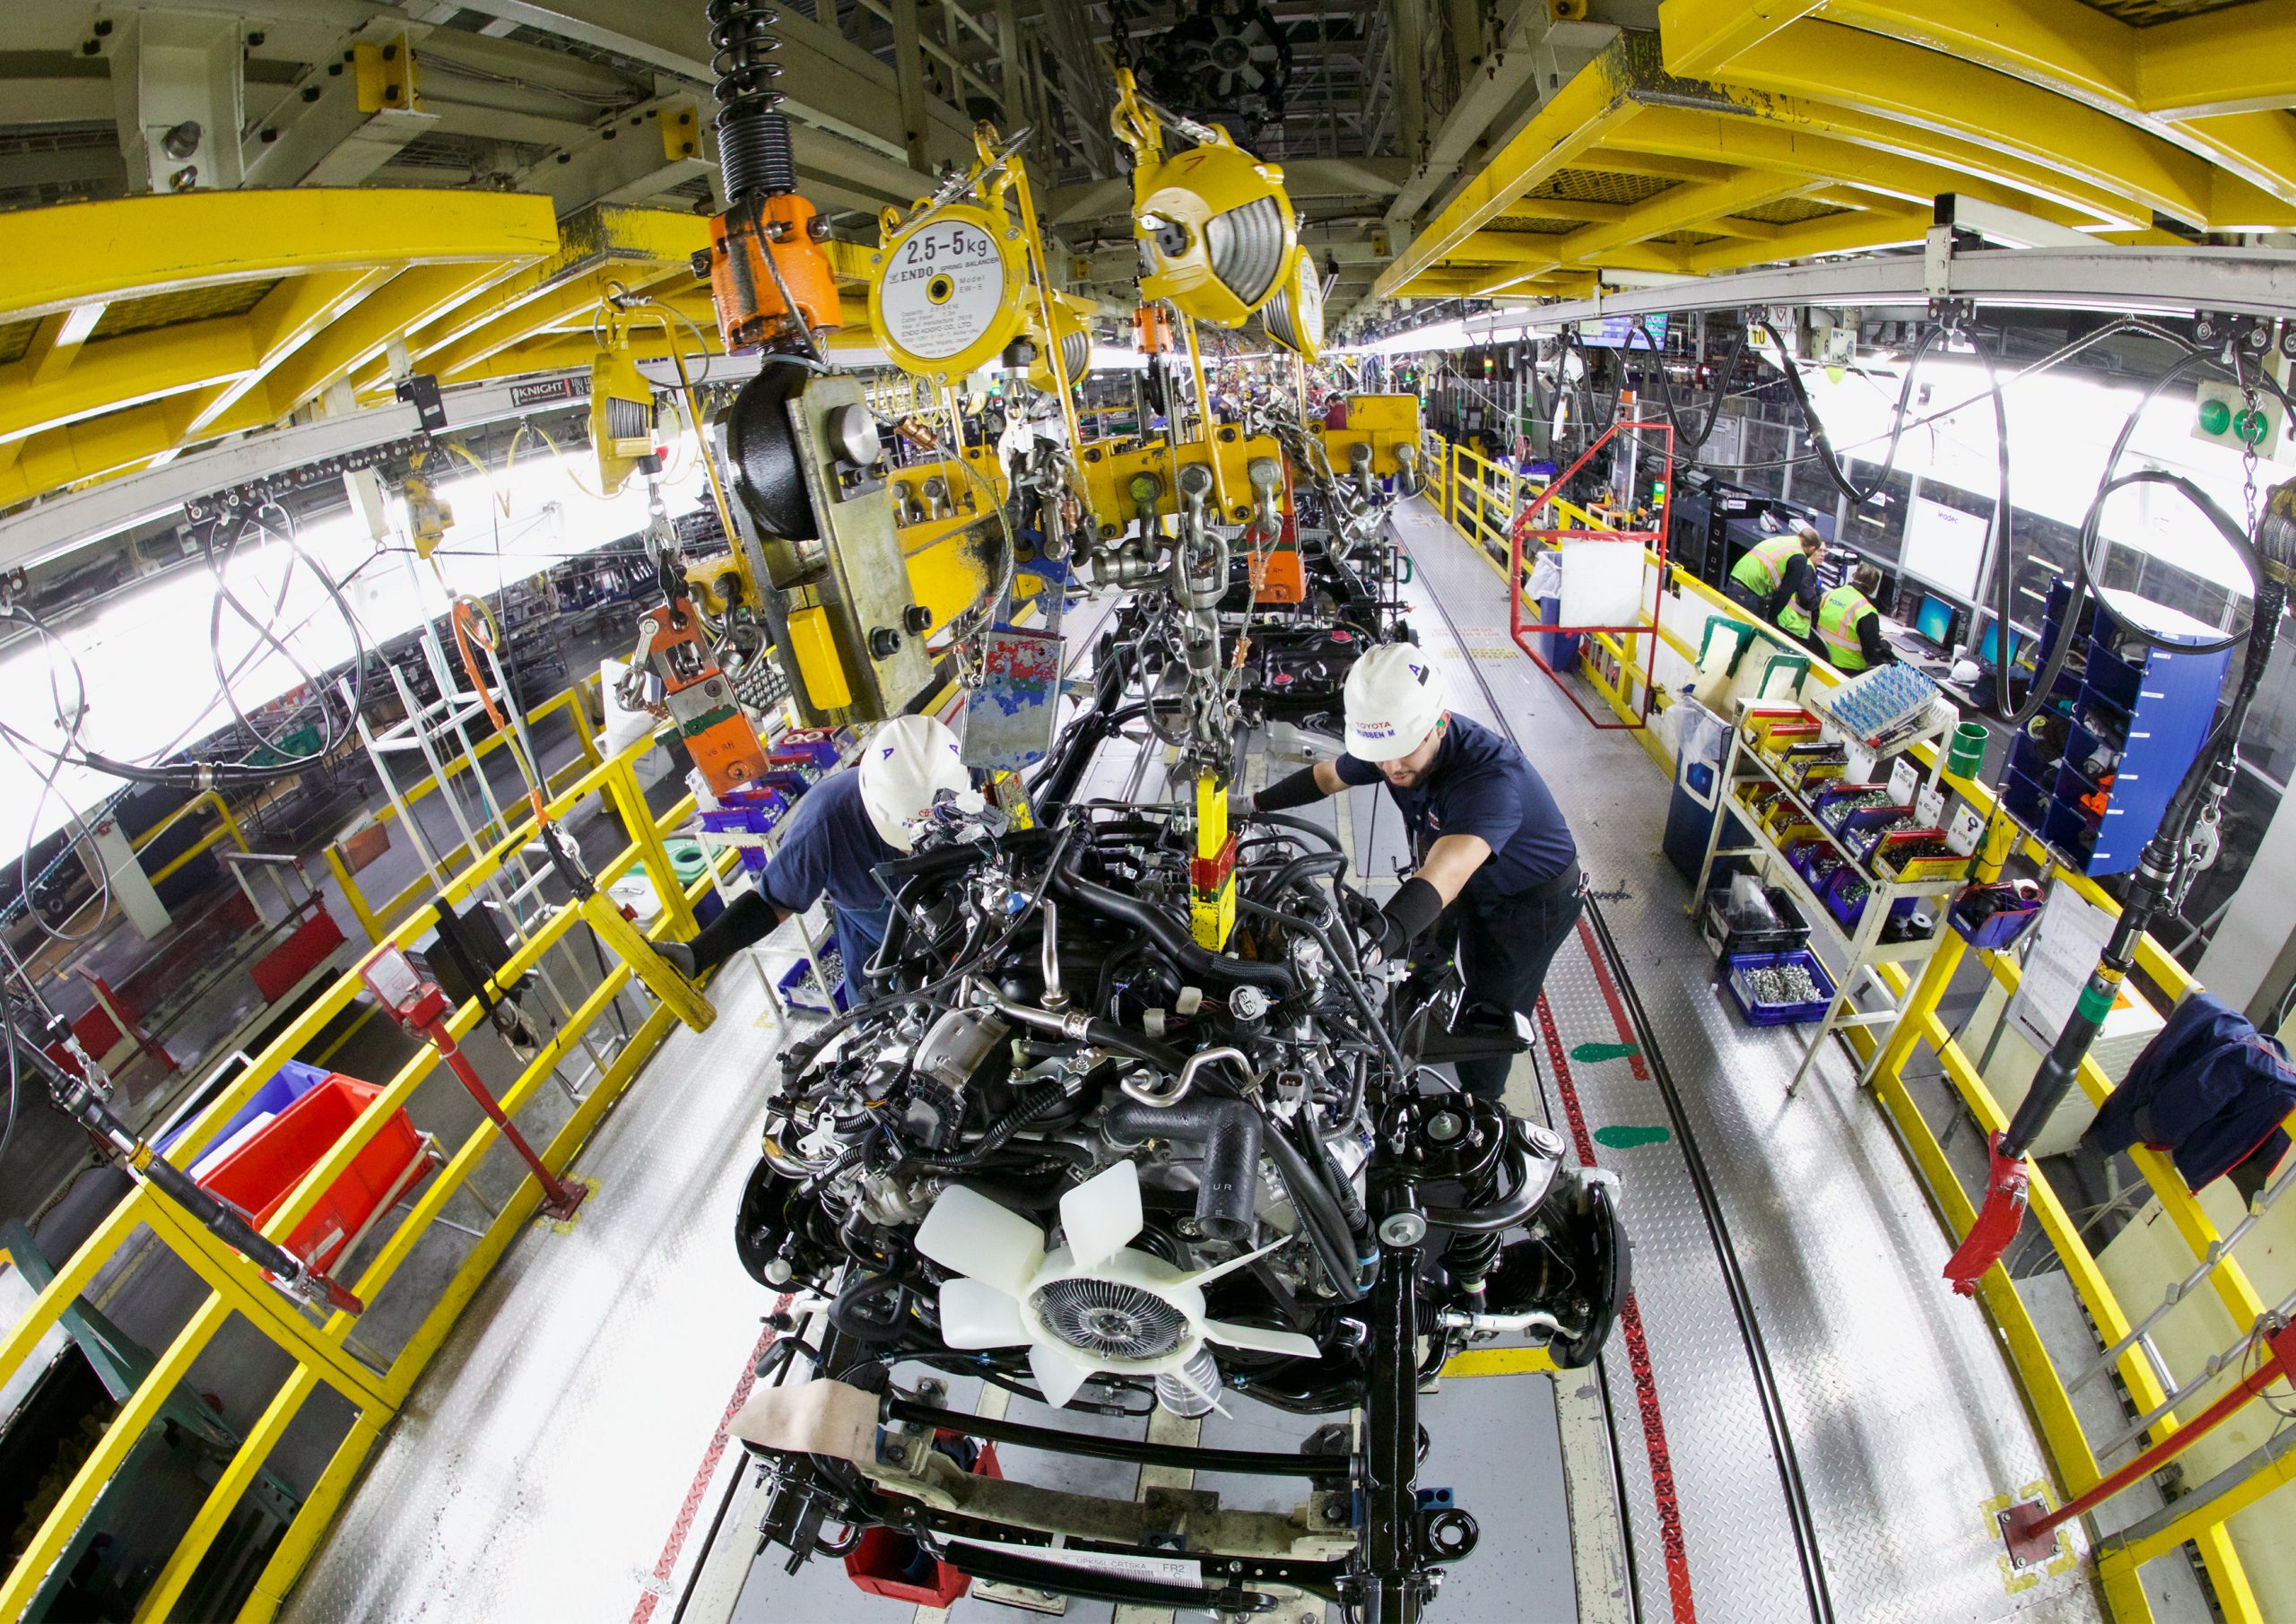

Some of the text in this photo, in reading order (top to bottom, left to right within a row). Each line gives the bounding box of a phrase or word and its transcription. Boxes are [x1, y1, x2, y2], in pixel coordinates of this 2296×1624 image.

[901, 257, 999, 282] ENDO SPRING BALANCER
[960, 274, 985, 284] Model
[519, 381, 563, 397] KNIGHT
[1938, 510, 1959, 525] leadec
[1408, 664, 1421, 677] A
[1355, 721, 1392, 730] TOYOTA
[1387, 729, 1396, 737] M
[882, 747, 894, 760] A
[949, 744, 960, 755] A
[1648, 1449, 1670, 1474] NOT
[1162, 1563, 1185, 1573] FR2
